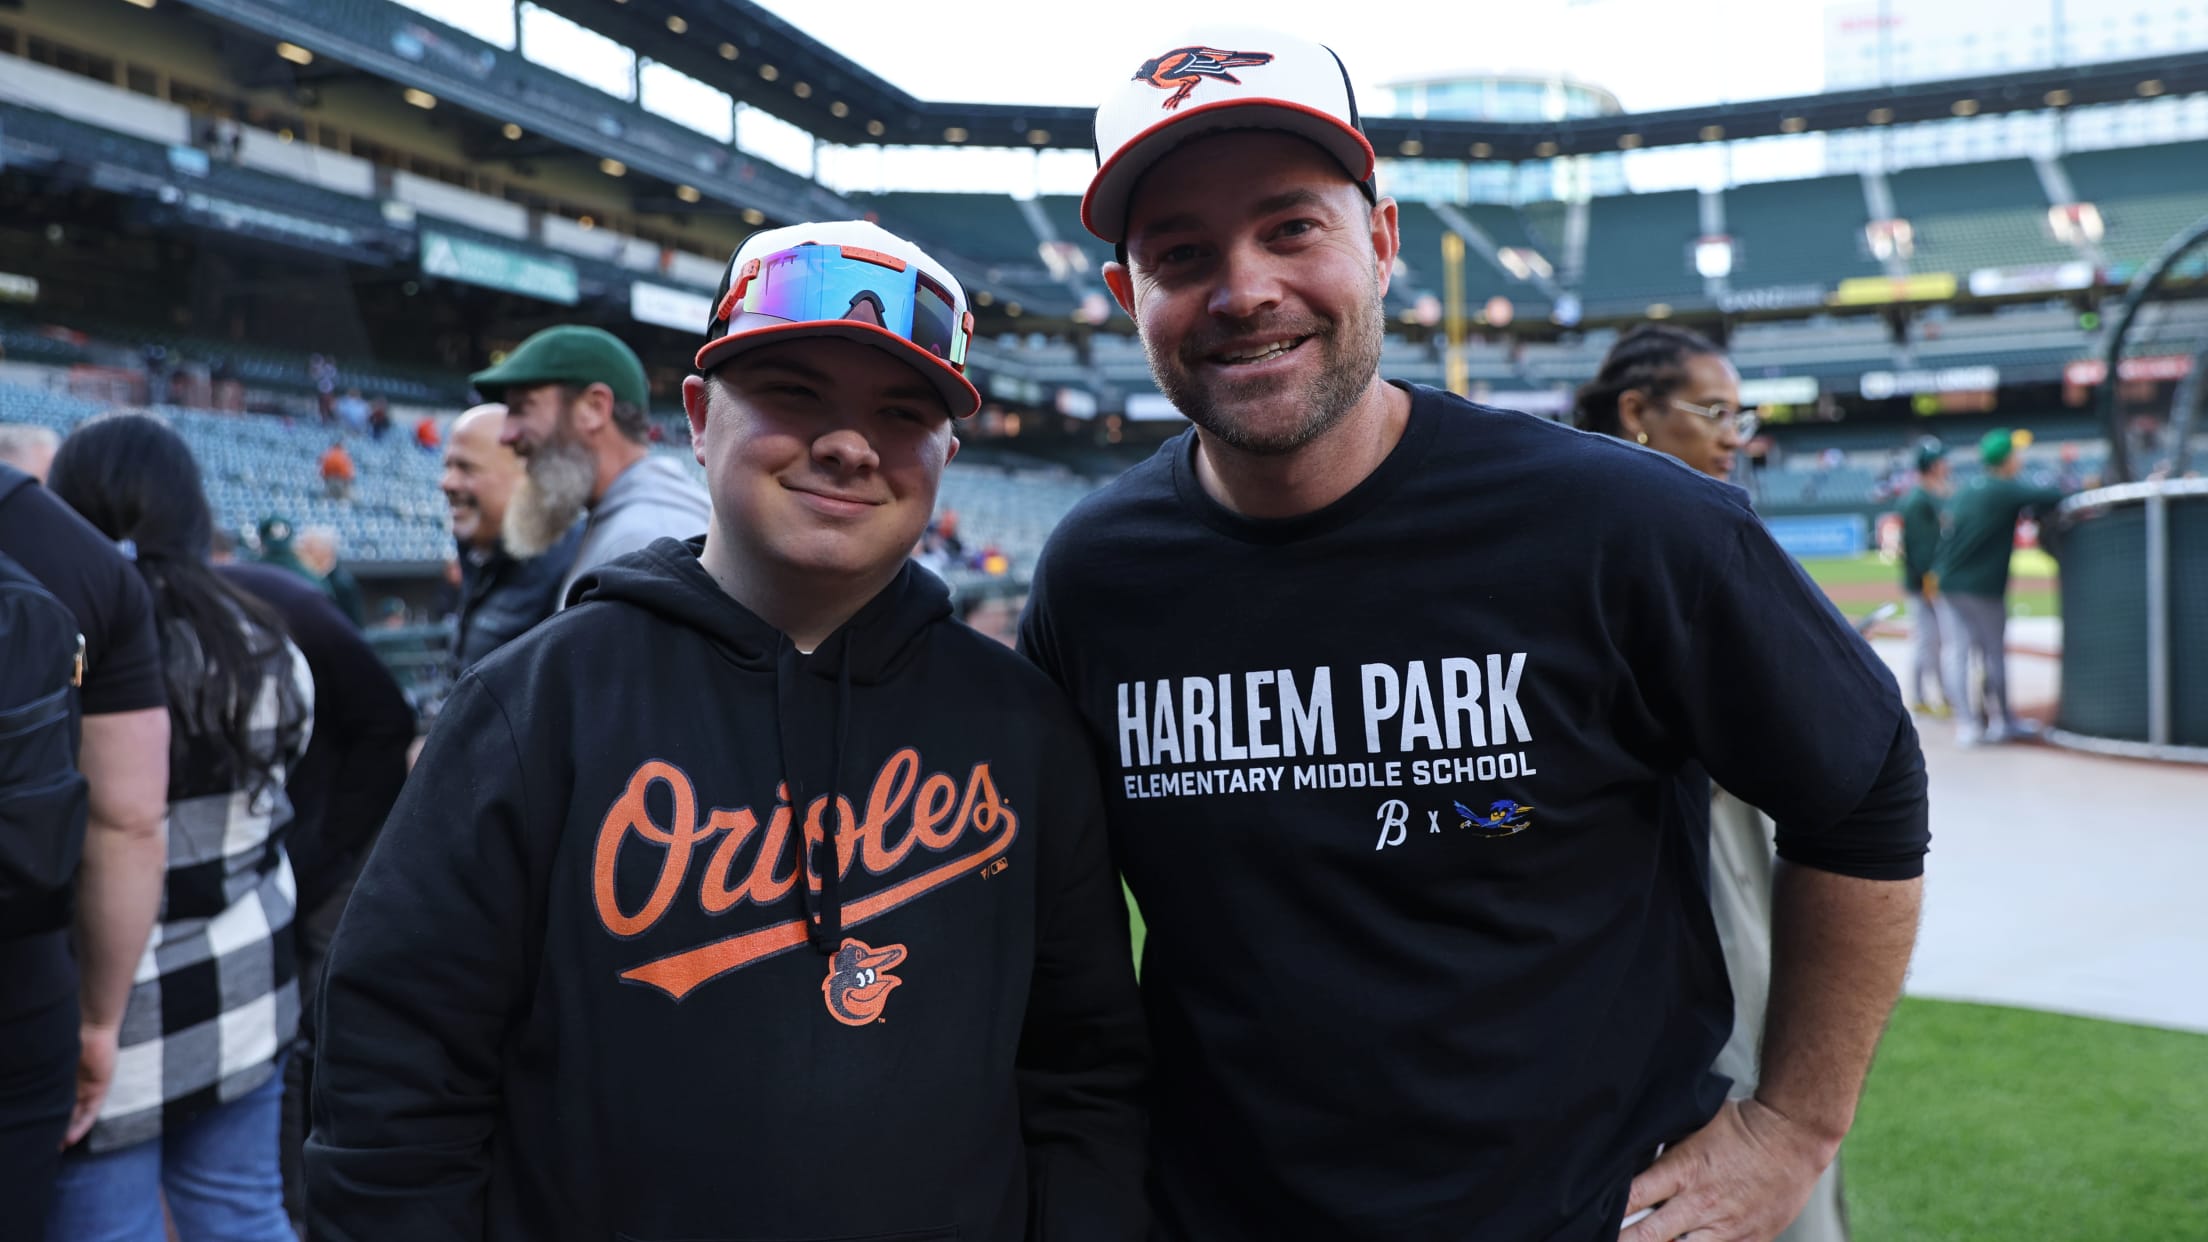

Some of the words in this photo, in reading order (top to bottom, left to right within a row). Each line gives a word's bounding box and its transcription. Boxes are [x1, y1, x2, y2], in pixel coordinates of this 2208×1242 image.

[1117, 665, 1337, 768] HARLEM
[1360, 652, 1533, 754] PARK
[1123, 766, 1286, 799] ELEMENTARY
[1293, 762, 1403, 790] MIDDLE
[1412, 751, 1537, 786] SCHOOL
[591, 746, 1018, 941] Orioles
[1375, 799, 1410, 851] B
